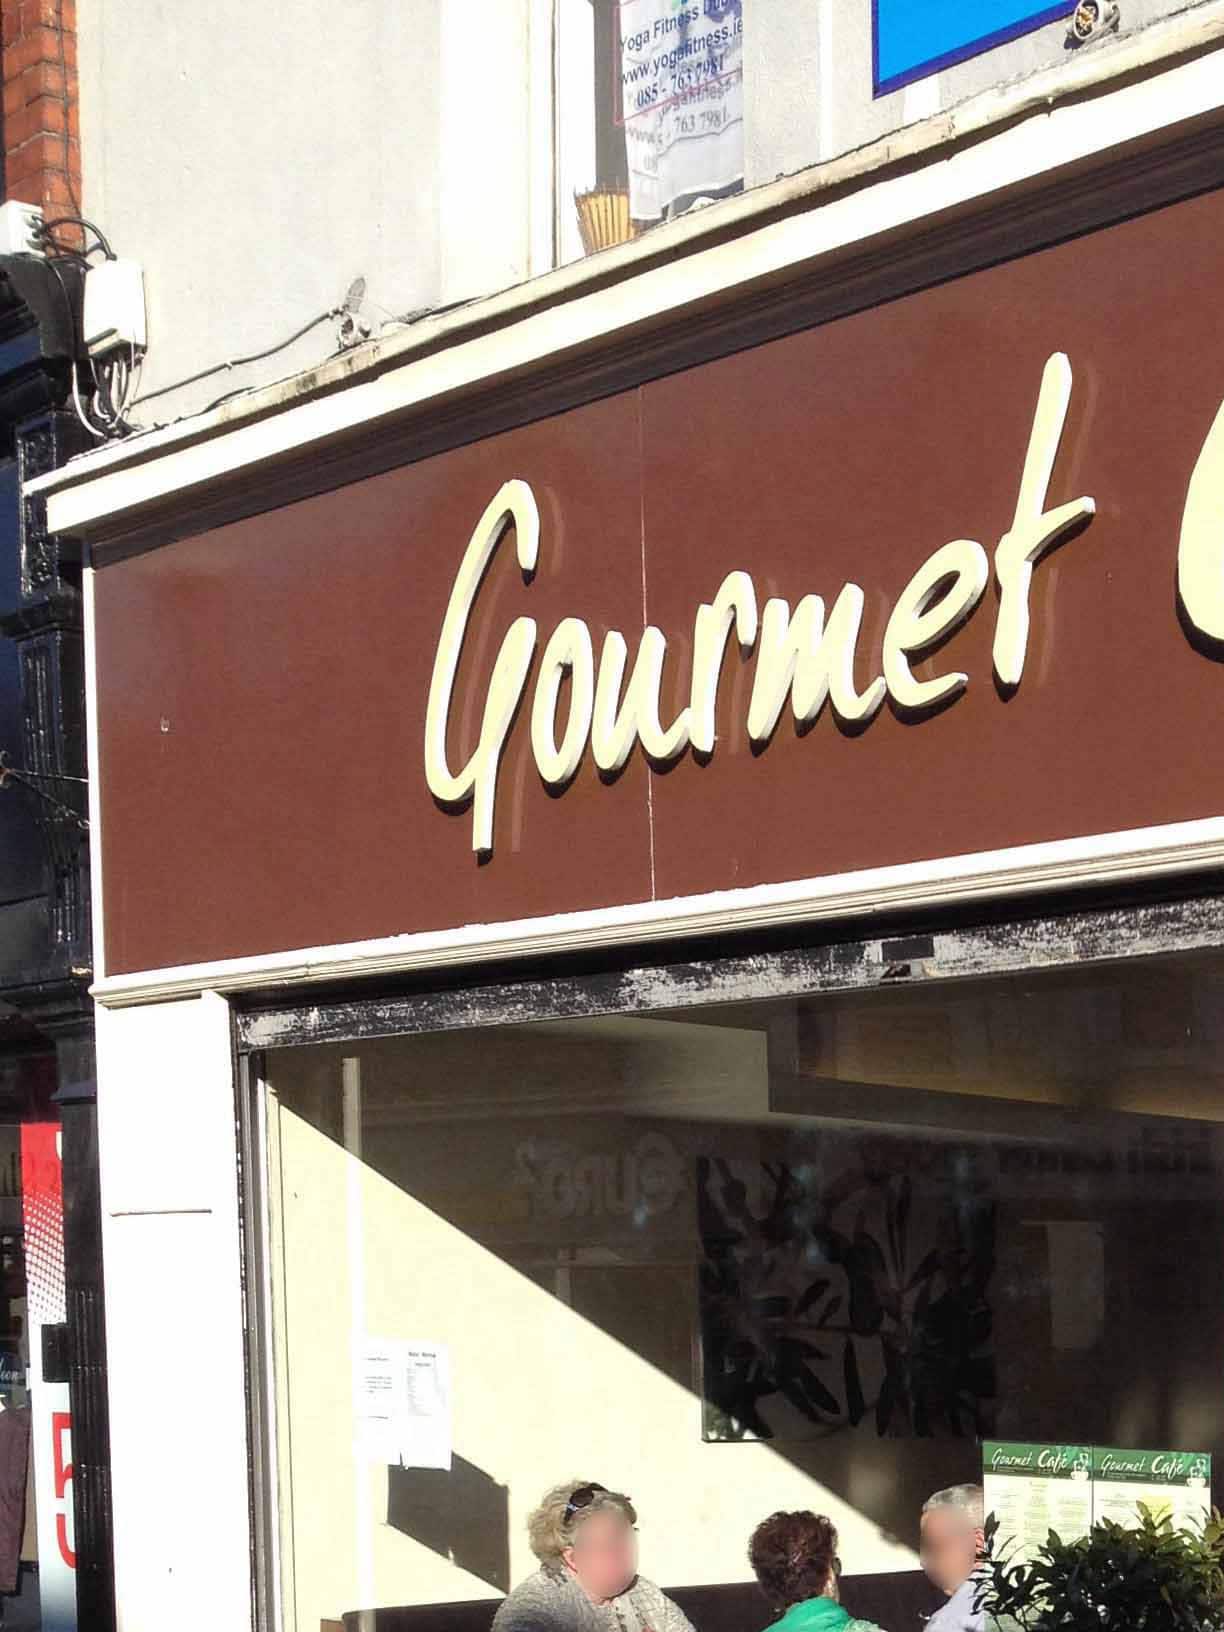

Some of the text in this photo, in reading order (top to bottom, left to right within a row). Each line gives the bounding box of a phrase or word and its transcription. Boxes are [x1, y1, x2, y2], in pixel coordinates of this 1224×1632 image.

[653, 5, 699, 40] Fitness
[637, 83, 658, 107] 085
[423, 351, 1096, 857] Gourmet
[991, 1447, 1069, 1475] Gourmet Café
[1100, 1453, 1184, 1480] Gourmet Café
